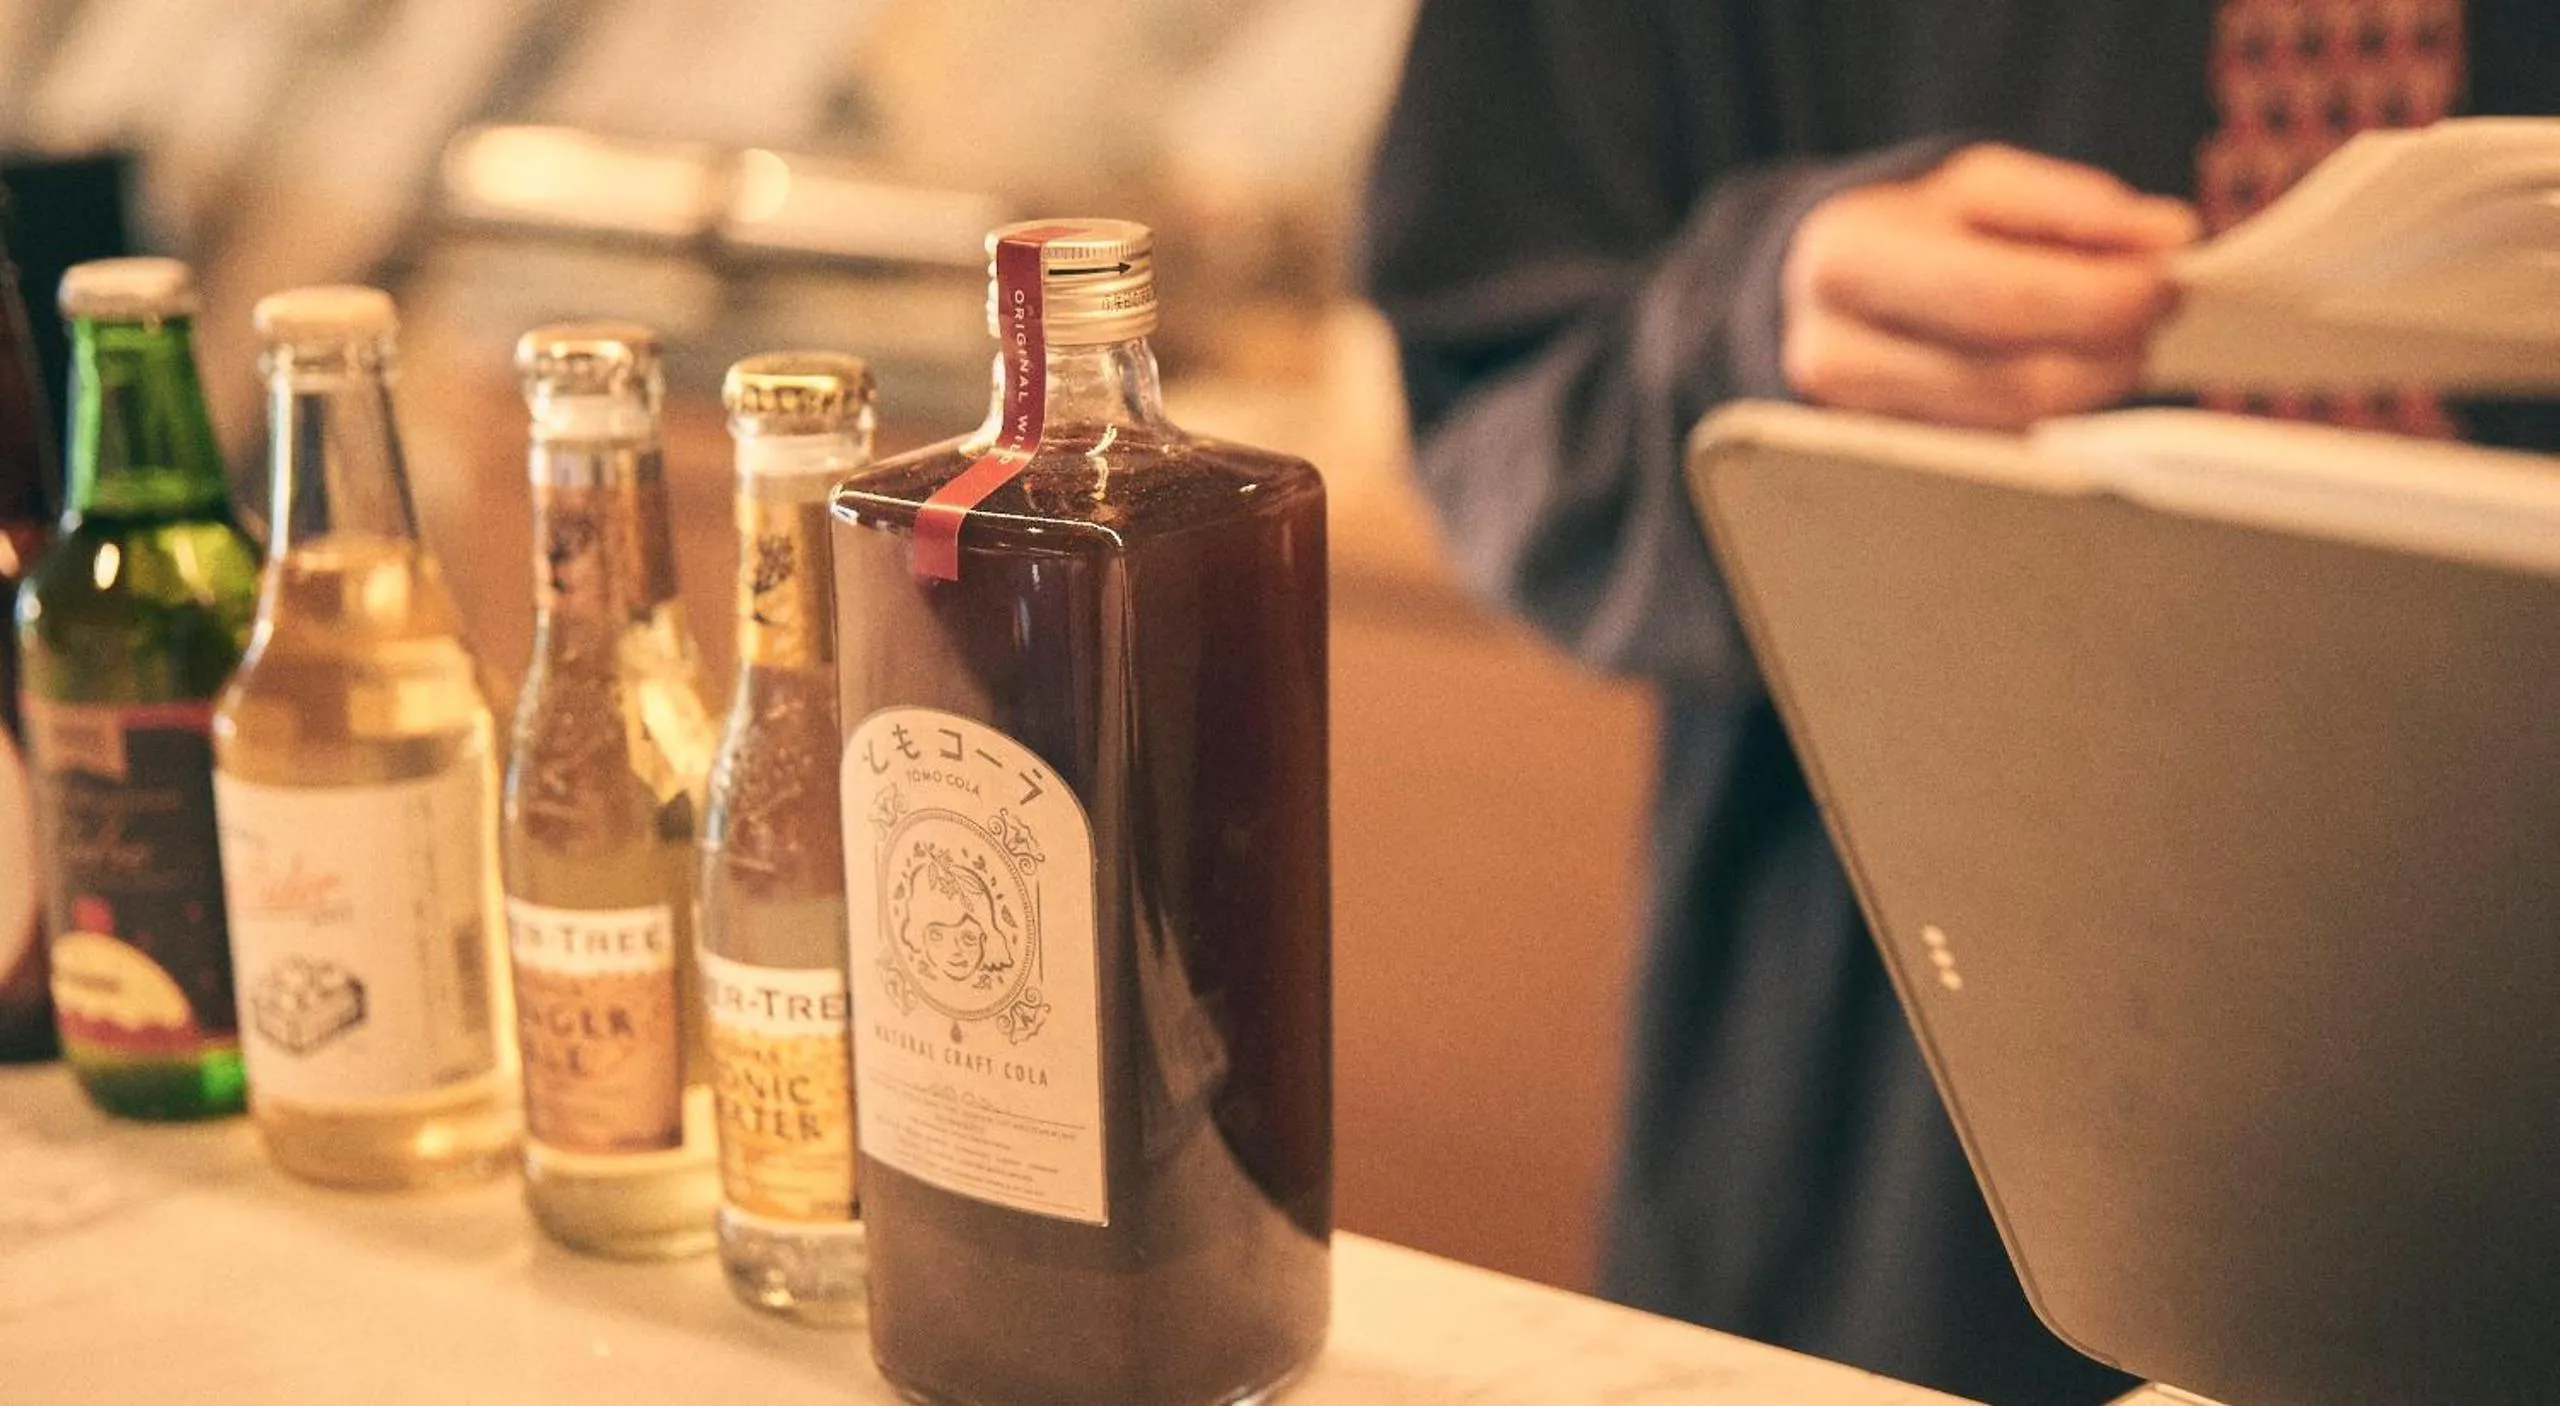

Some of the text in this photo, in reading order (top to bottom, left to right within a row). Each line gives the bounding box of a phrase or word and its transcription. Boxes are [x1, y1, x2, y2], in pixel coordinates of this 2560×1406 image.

[1014, 289, 1031, 404] ORIGINAL
[906, 769, 981, 796] TOMO COLA
[945, 1048, 993, 1075] CRAFT
[1004, 1061, 1048, 1087] COLA
